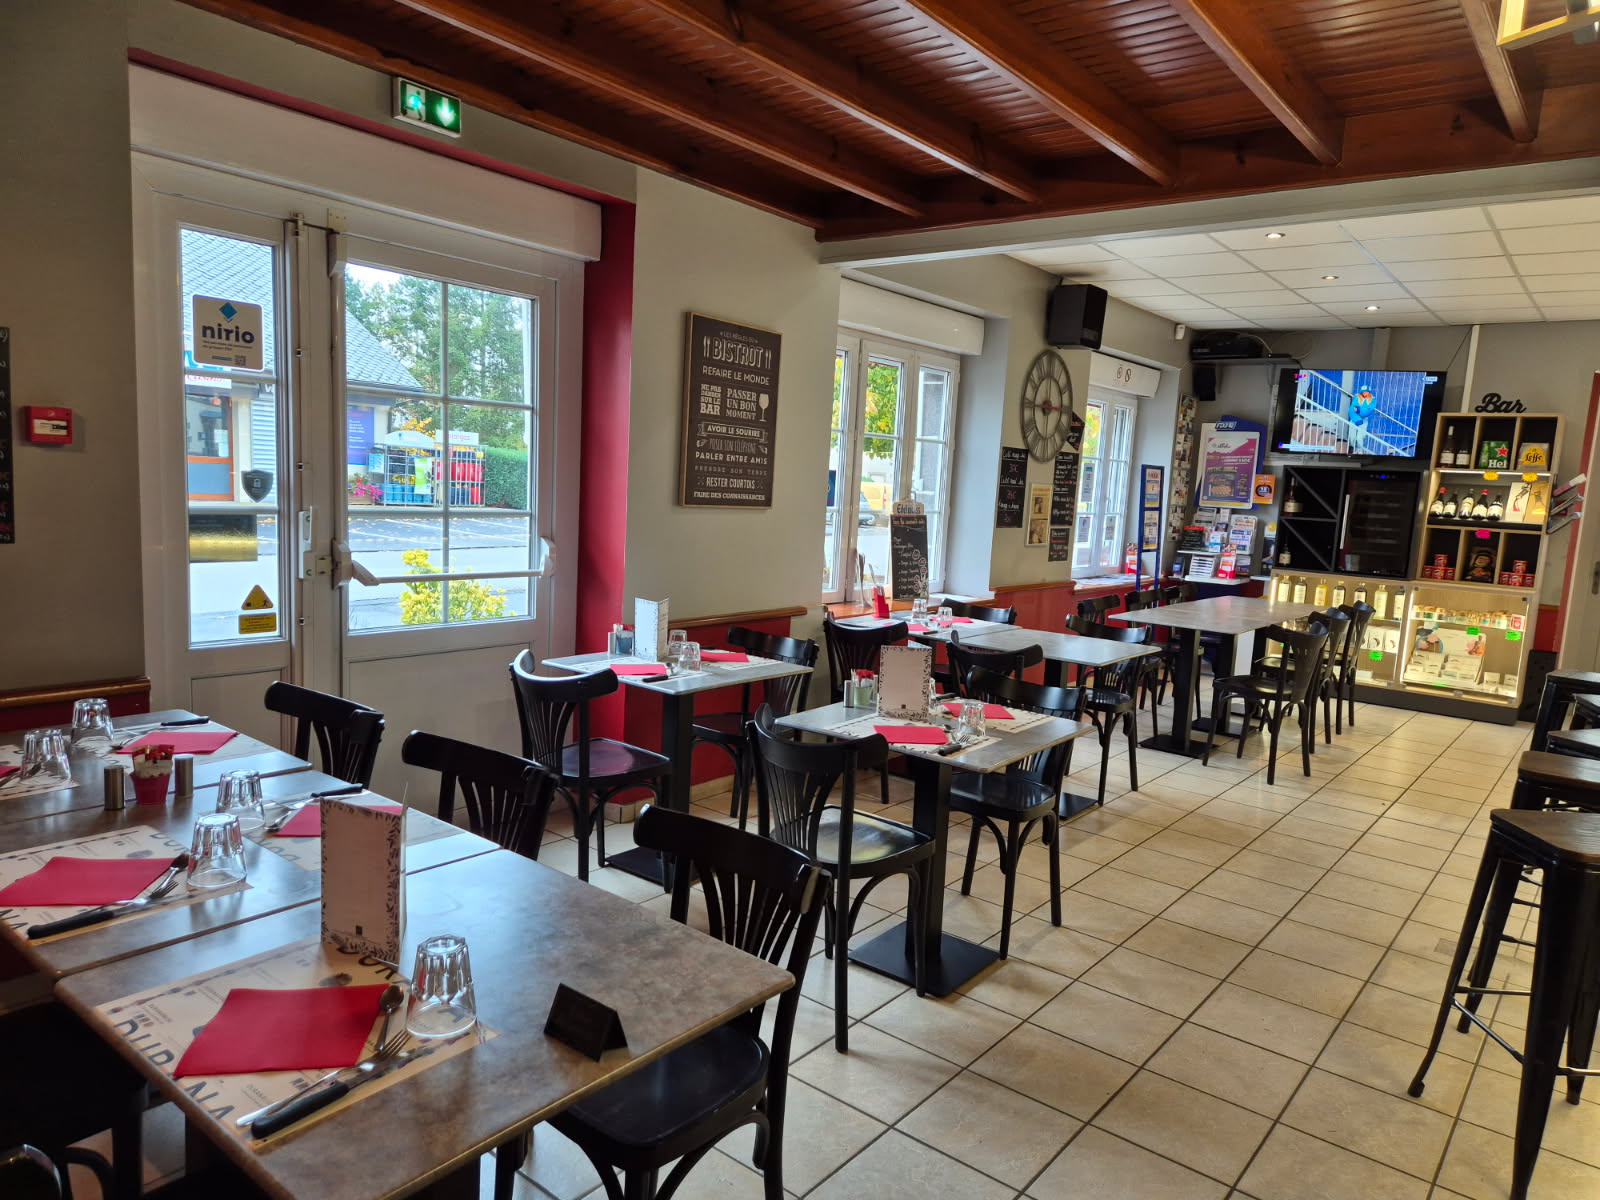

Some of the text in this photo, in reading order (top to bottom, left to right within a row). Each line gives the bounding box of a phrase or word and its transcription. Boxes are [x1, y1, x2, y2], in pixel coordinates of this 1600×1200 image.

[202, 323, 255, 344] nirio
[712, 336, 764, 368] BISTROT
[702, 365, 770, 386] REFAIRE LE MONDE
[713, 397, 721, 405] LE
[727, 388, 757, 402] PASSER
[700, 403, 721, 416] BAR
[726, 399, 757, 411] UN BON
[1475, 392, 1527, 414] Bar
[725, 409, 757, 420] MOMENT
[707, 425, 761, 438] AVOIR LE SOURIRE
[695, 451, 768, 465] PARLER ENTRE AMIS
[1526, 452, 1543, 463] Leffe
[706, 477, 756, 489] RESTER COURTOIS
